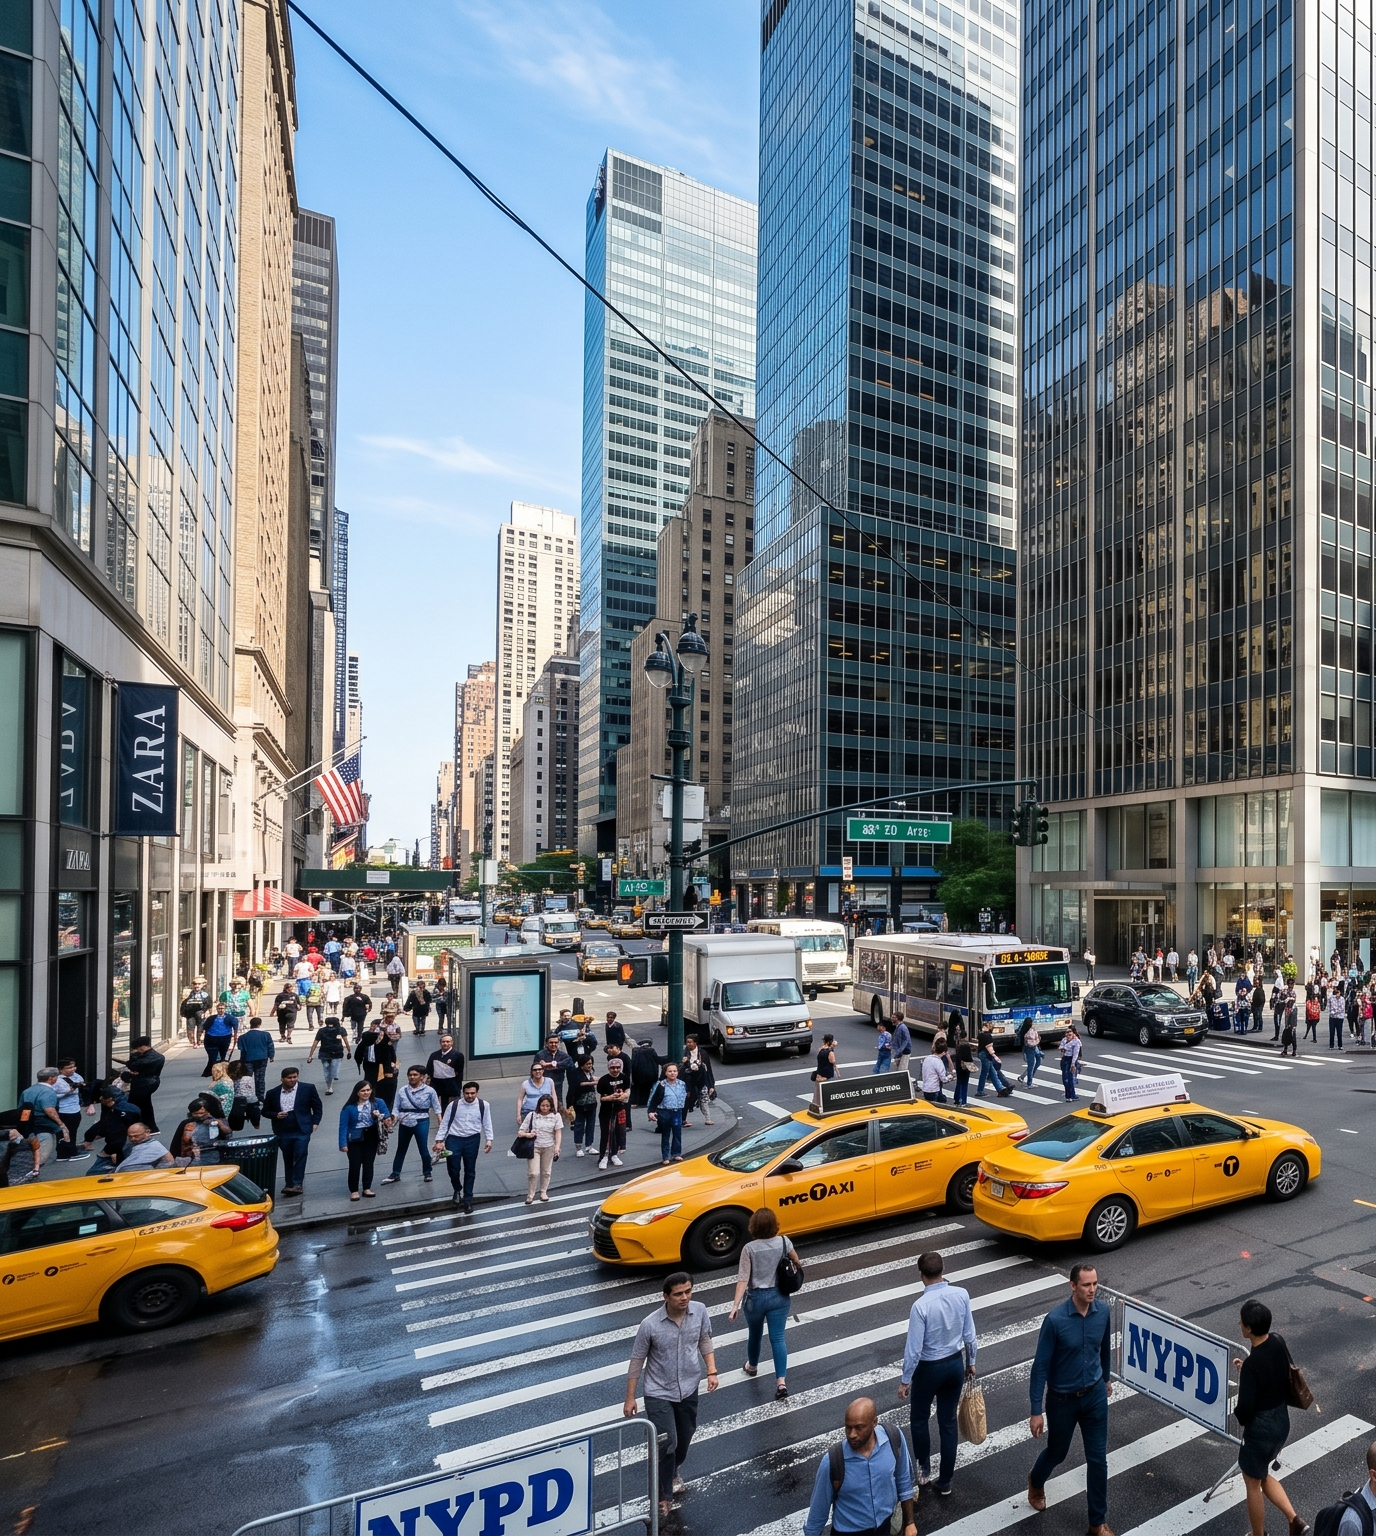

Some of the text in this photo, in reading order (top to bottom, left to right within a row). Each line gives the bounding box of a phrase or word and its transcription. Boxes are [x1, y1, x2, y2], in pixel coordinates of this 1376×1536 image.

[132, 706, 165, 813] ZARA
[779, 1193, 809, 1207] NYC
[1127, 1322, 1219, 1405] NYPD
